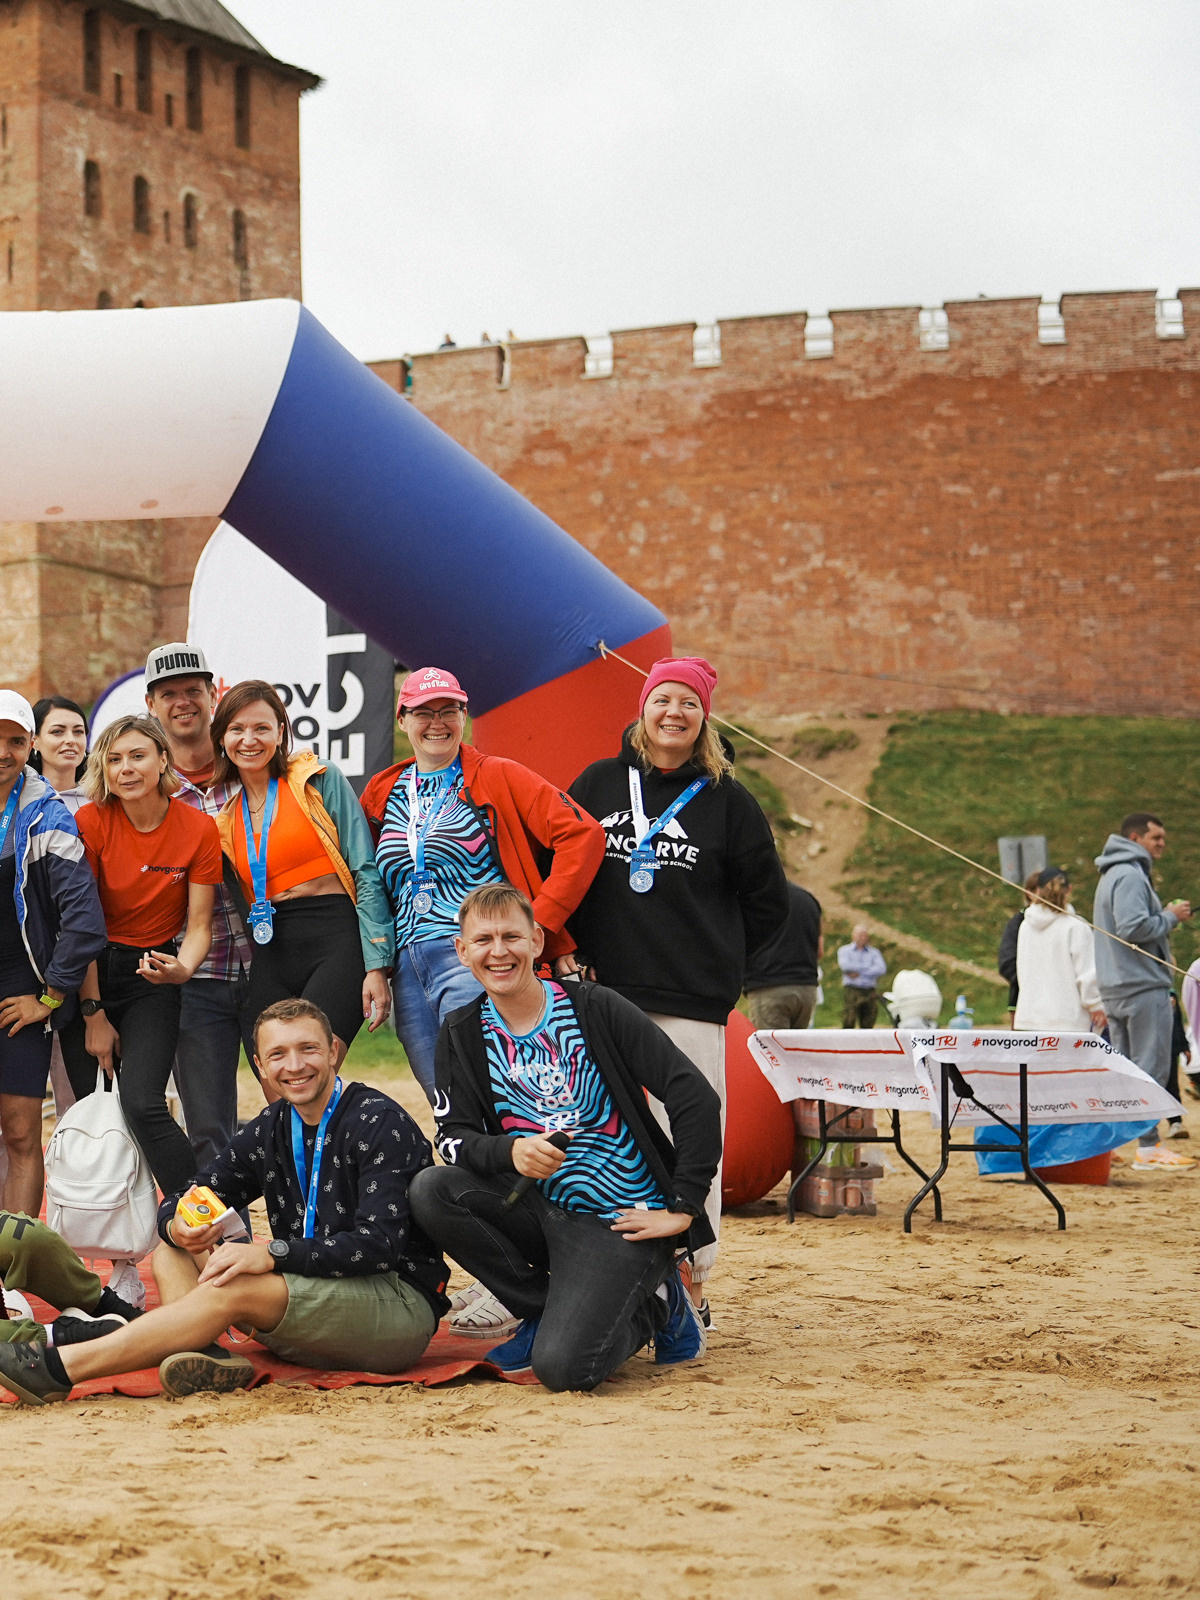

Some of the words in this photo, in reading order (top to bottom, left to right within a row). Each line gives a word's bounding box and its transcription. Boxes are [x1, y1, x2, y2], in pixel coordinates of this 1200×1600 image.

[155, 653, 200, 674] PUMA
[690, 781, 702, 792] 2023
[670, 860, 693, 871] SCHOOL
[508, 1059, 560, 1082] #nov
[540, 1071, 566, 1095] go
[535, 1084, 575, 1112] rod
[536, 1109, 581, 1132] TRI
